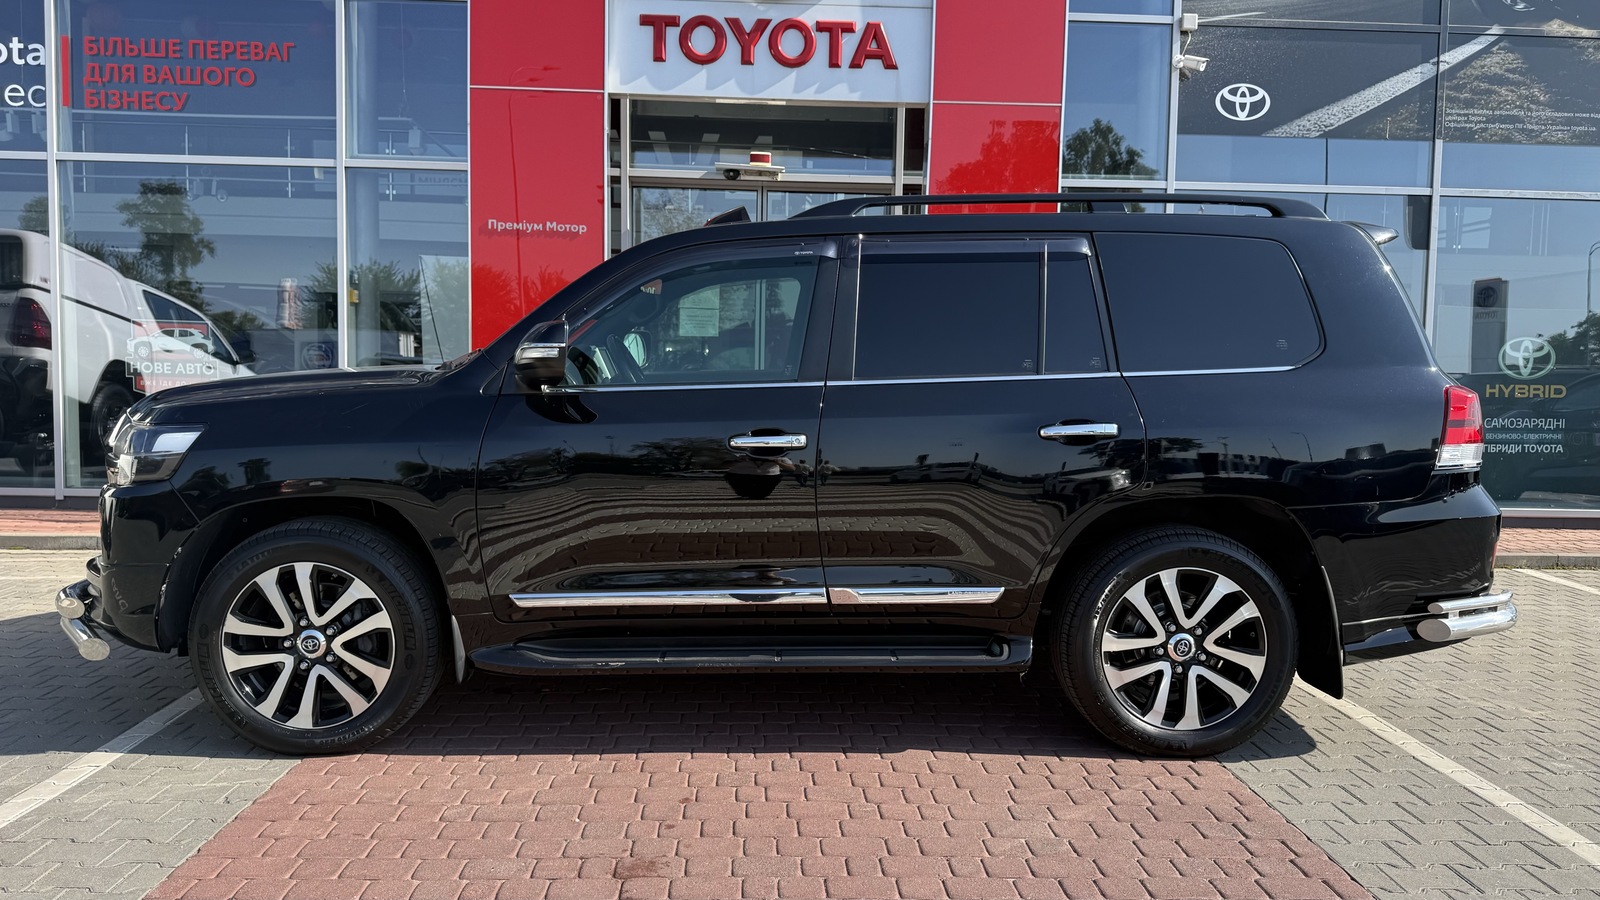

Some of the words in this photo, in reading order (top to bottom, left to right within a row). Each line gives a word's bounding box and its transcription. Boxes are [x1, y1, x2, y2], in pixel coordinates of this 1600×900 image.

[84, 36, 180, 58] БІЛЬШЕ
[188, 40, 295, 61] ПЕРЕВАГ
[640, 14, 899, 70] TOYOTA
[83, 63, 135, 86] ДЛЯ
[143, 65, 255, 87] ВАШОГО
[85, 89, 188, 111] БІЗНЕСУ
[488, 219, 543, 233] Преміум
[546, 221, 587, 234] Мотор
[130, 361, 171, 374] НОВЕ
[175, 362, 215, 375] АВТО
[1485, 384, 1567, 398] HYBRID
[1484, 418, 1565, 430] САМОЗАРЯДНІ
